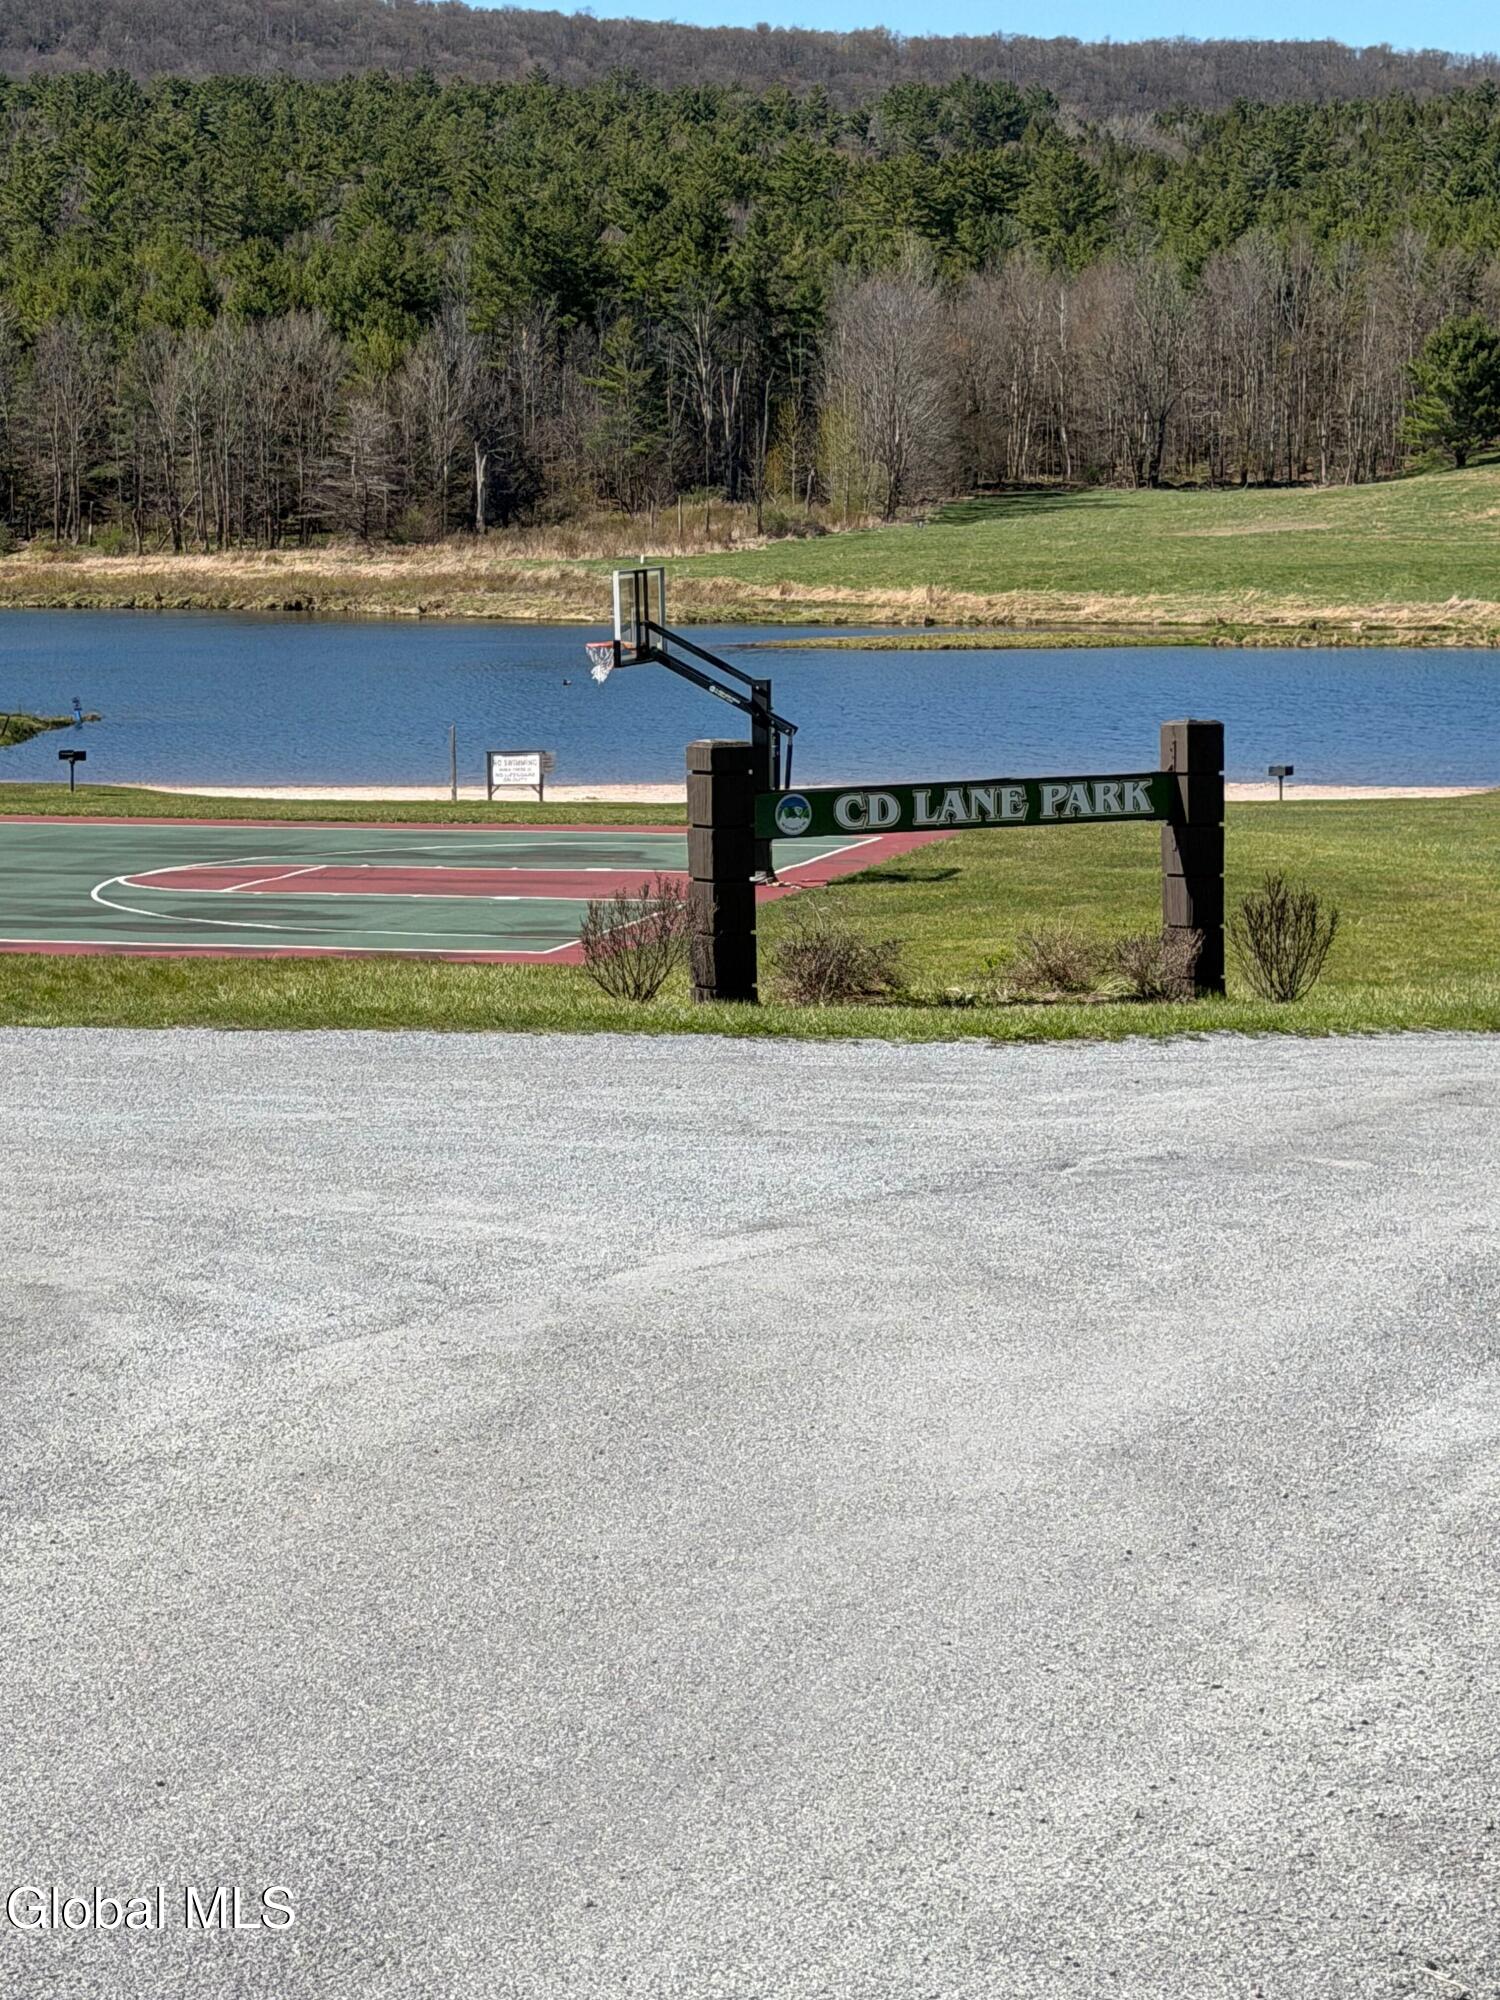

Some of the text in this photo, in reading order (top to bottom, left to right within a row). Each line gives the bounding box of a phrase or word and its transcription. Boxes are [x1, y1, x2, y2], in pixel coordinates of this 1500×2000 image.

[833, 778, 1155, 830] CD LANE PARK
